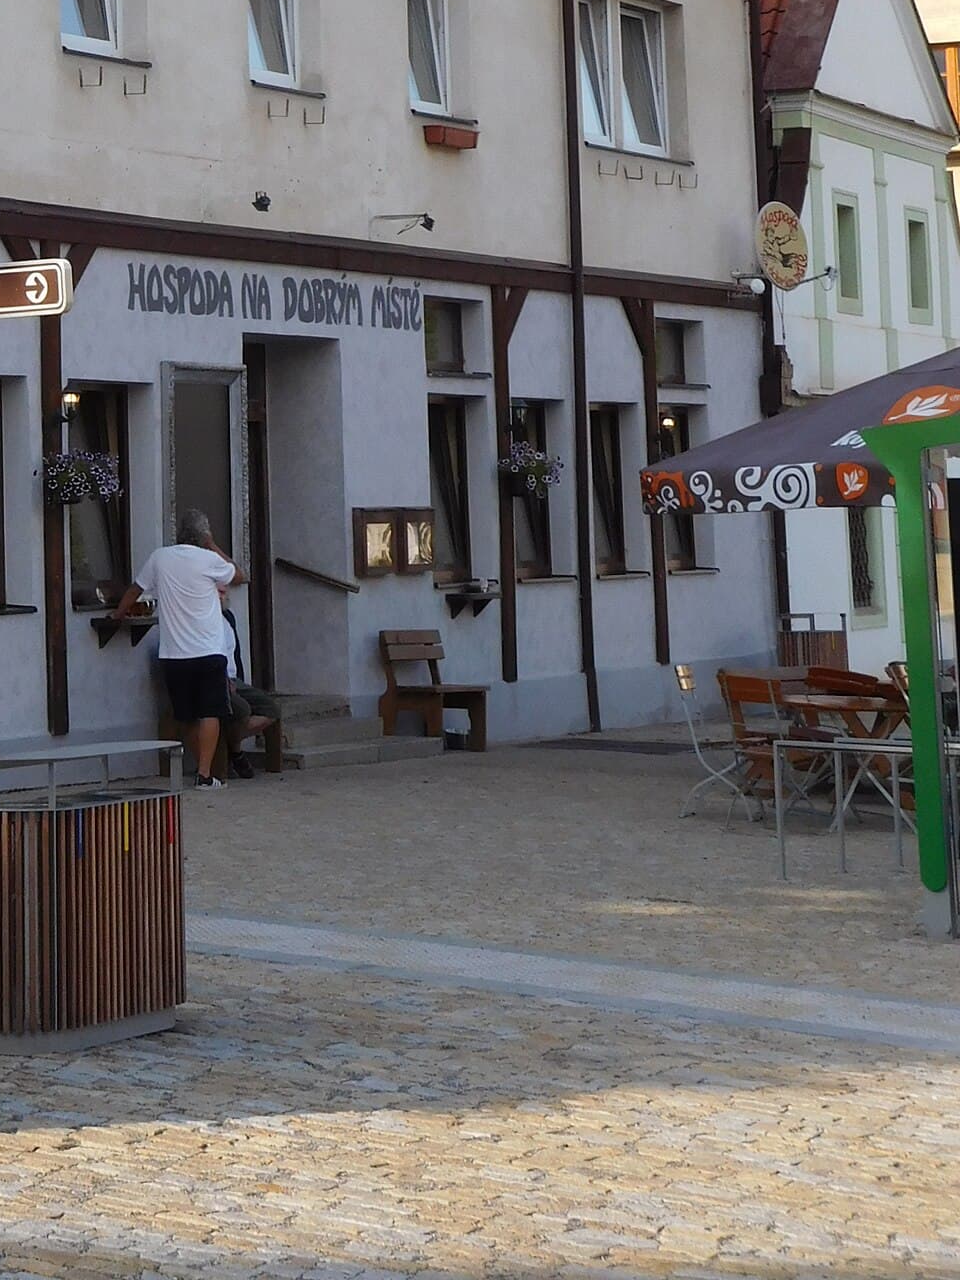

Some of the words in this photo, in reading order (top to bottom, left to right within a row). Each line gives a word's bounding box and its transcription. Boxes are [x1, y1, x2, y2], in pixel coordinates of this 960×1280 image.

[127, 262, 234, 318] HOSPODA
[241, 272, 272, 321] NA
[282, 274, 363, 327] DOBRÝM
[371, 275, 422, 332] MÍSTĚ
